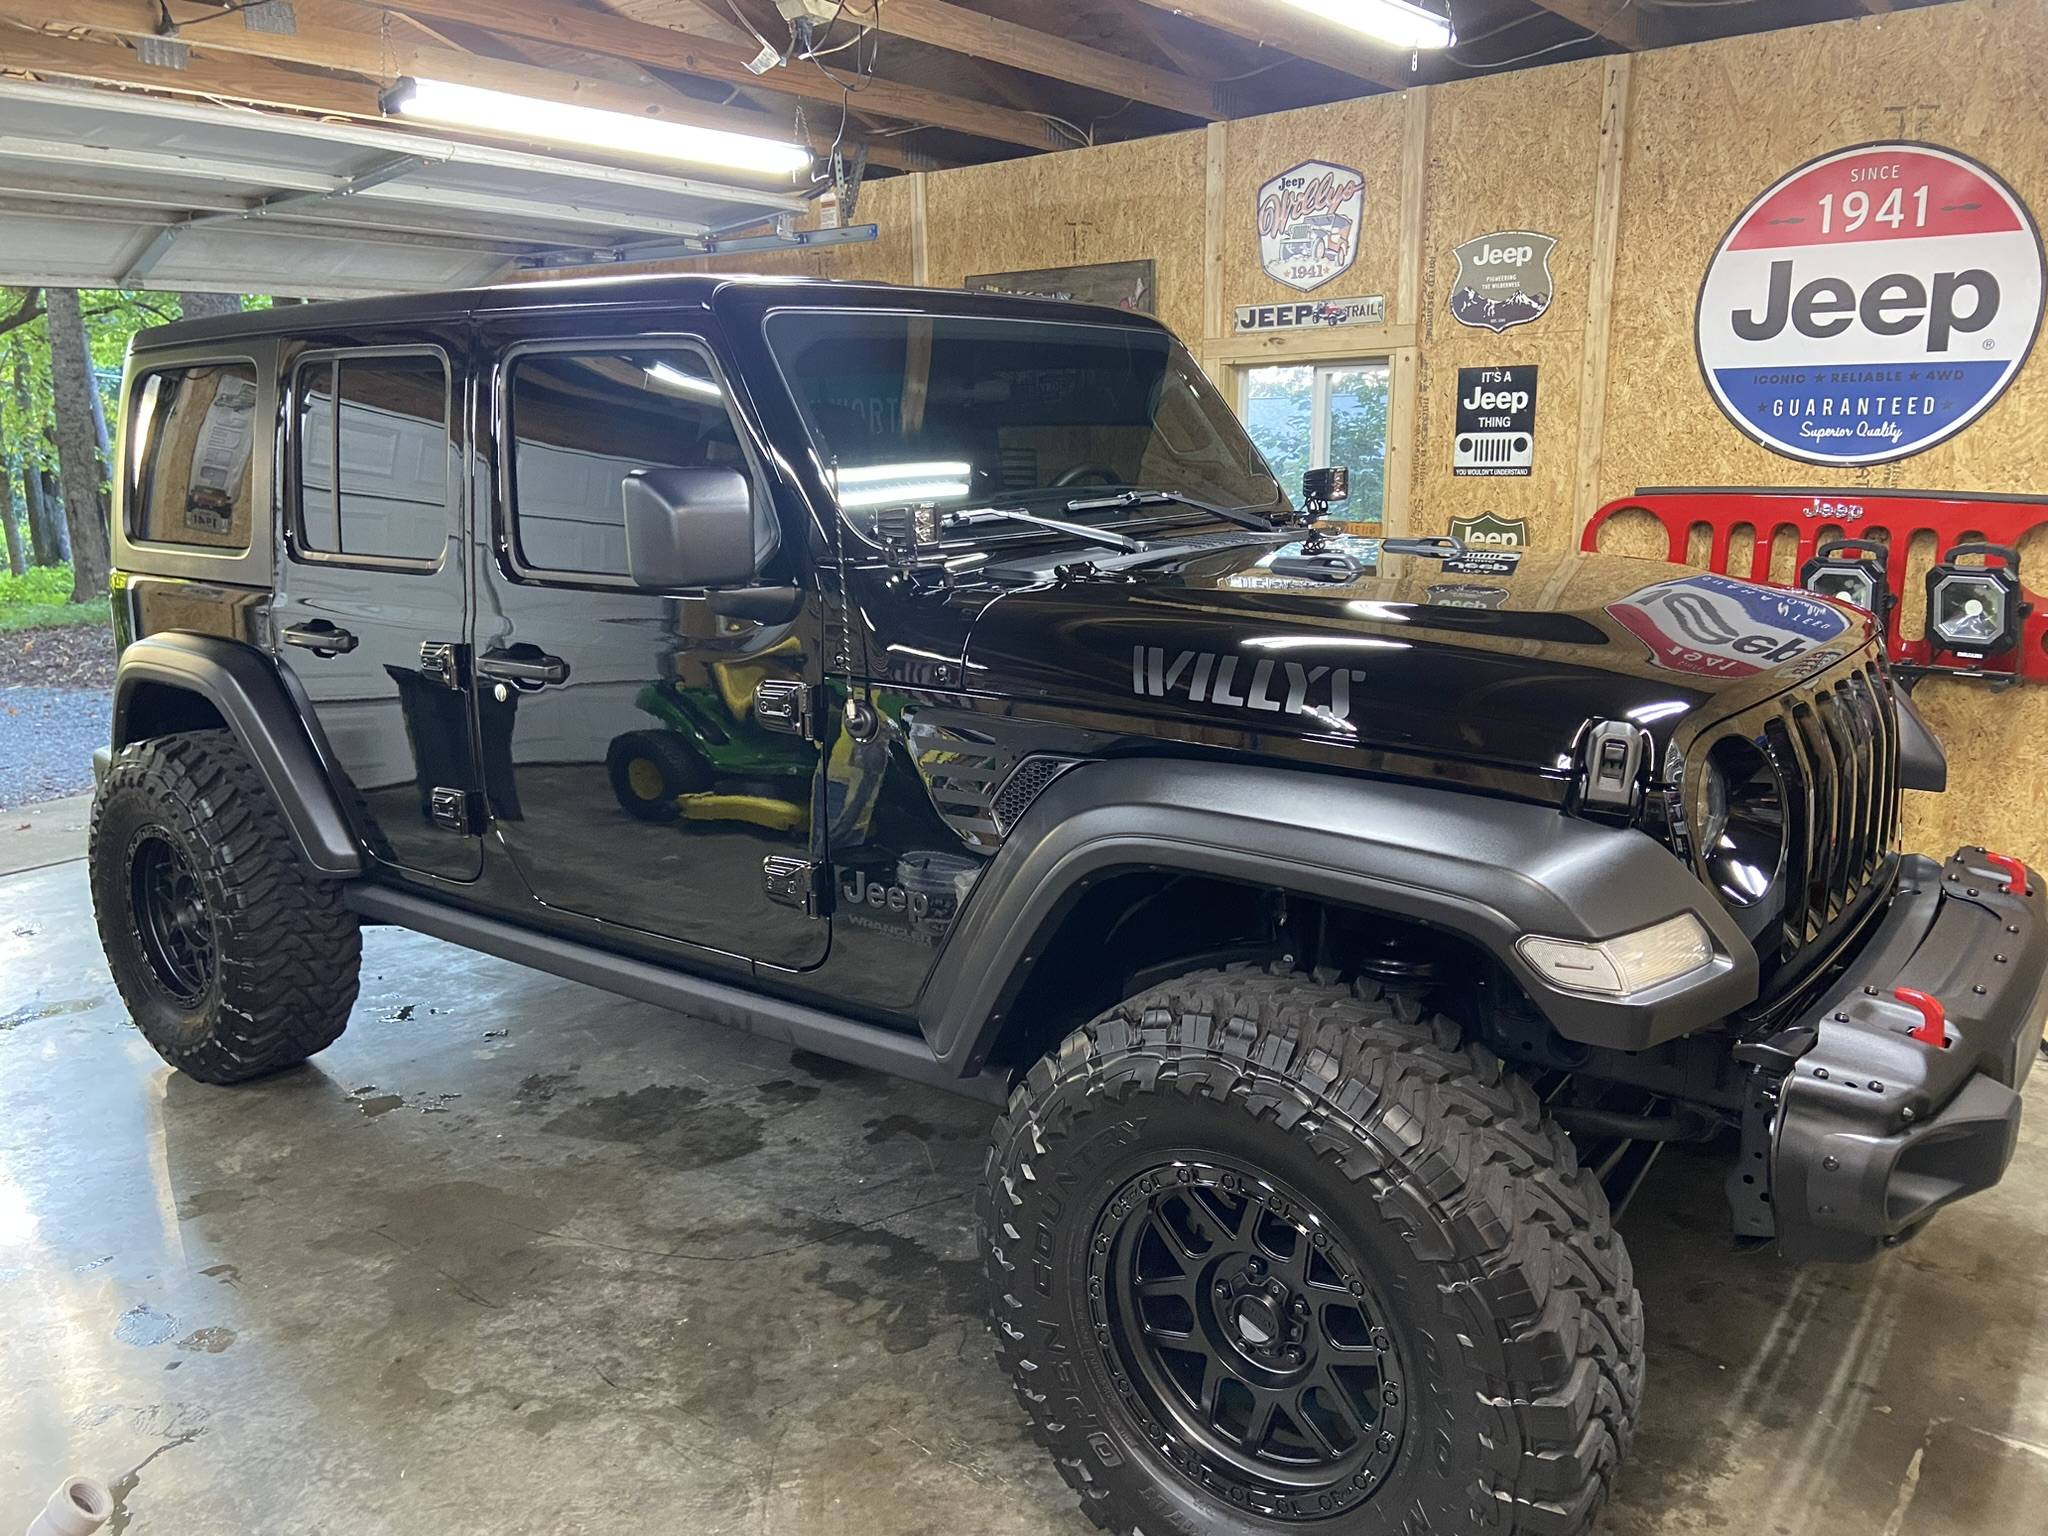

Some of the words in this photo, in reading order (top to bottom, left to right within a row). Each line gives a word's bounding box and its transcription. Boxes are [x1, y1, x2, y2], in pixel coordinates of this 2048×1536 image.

[1278, 177, 1305, 191] Jeep
[1849, 164, 1901, 183] SINCE
[1258, 172, 1365, 239] Willys
[1818, 184, 1929, 234] 1941
[1473, 244, 1533, 267] Jeep
[1291, 265, 1324, 280] 1941
[1486, 274, 1517, 283] PIONEERING
[1240, 305, 1314, 329] JEEP
[1345, 302, 1378, 318] TRAIL
[1731, 259, 2001, 353] Jeep
[1481, 371, 1502, 383] IT'S
[1503, 371, 1512, 383] A
[1753, 373, 1806, 385] ICONIC
[1831, 370, 1903, 383] RELIABLE
[1926, 369, 1964, 381] 4WD
[1463, 386, 1529, 414] Jeep
[1772, 396, 1936, 417] GUARANTEED
[1478, 416, 1511, 428] THING
[1800, 420, 1853, 443] Superior
[1856, 420, 1903, 444] Quality
[1455, 468, 1466, 476] YOU
[1467, 468, 1494, 476] WOULDN'T
[1494, 468, 1528, 476] UNDERSTAND
[1802, 498, 1864, 521] Jeep
[1132, 645, 1367, 720] WILLYS
[843, 870, 929, 924] Jeep
